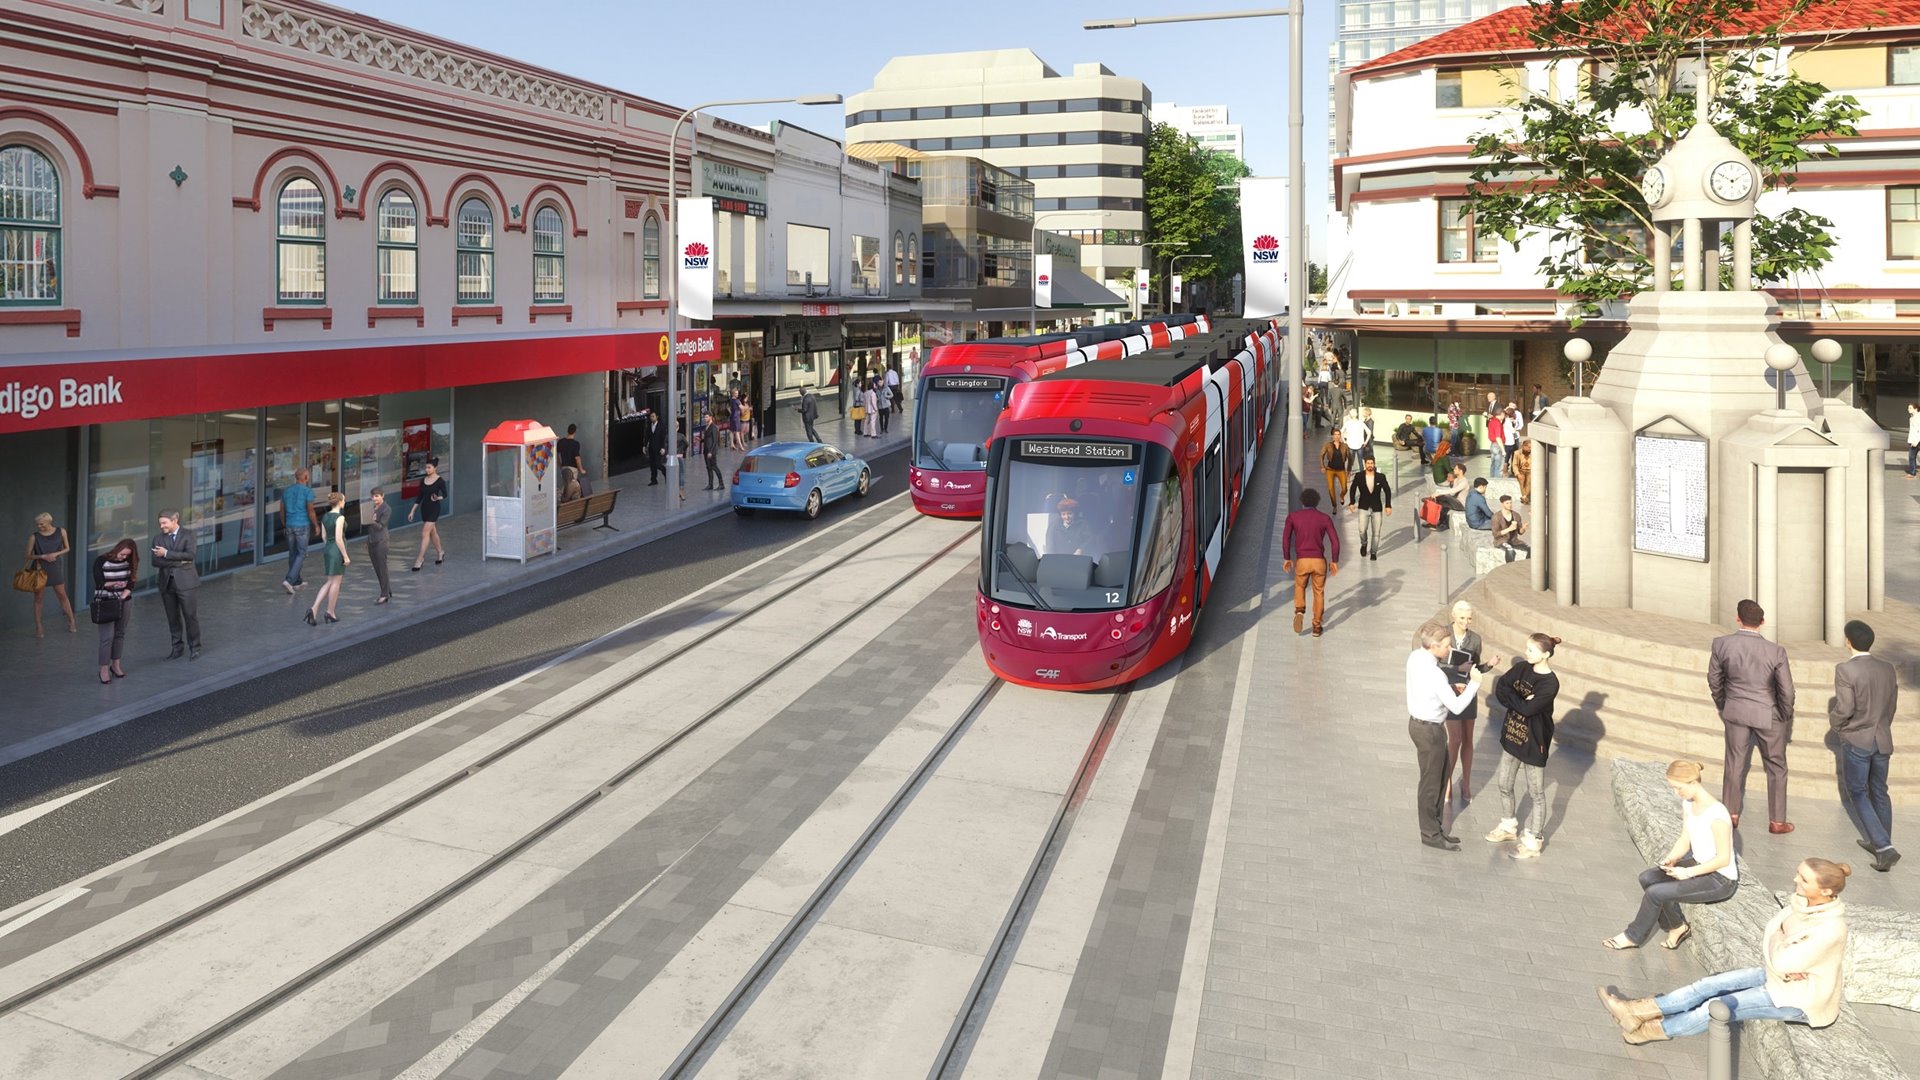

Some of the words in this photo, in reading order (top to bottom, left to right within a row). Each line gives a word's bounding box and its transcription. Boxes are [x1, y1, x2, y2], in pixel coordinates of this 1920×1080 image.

[1253, 251, 1278, 260] NSW
[684, 257, 709, 266] NSW
[675, 338, 697, 356] endigo
[697, 336, 714, 352] Bank
[946, 380, 988, 388] Carlingford
[60, 375, 123, 409] Bank
[1028, 444, 1081, 455] Westmead
[1085, 445, 1125, 457] Station
[1105, 592, 1120, 604] 12
[1017, 627, 1033, 635] NSW
[1057, 632, 1088, 642] Transport
[1035, 668, 1061, 679] CAF
